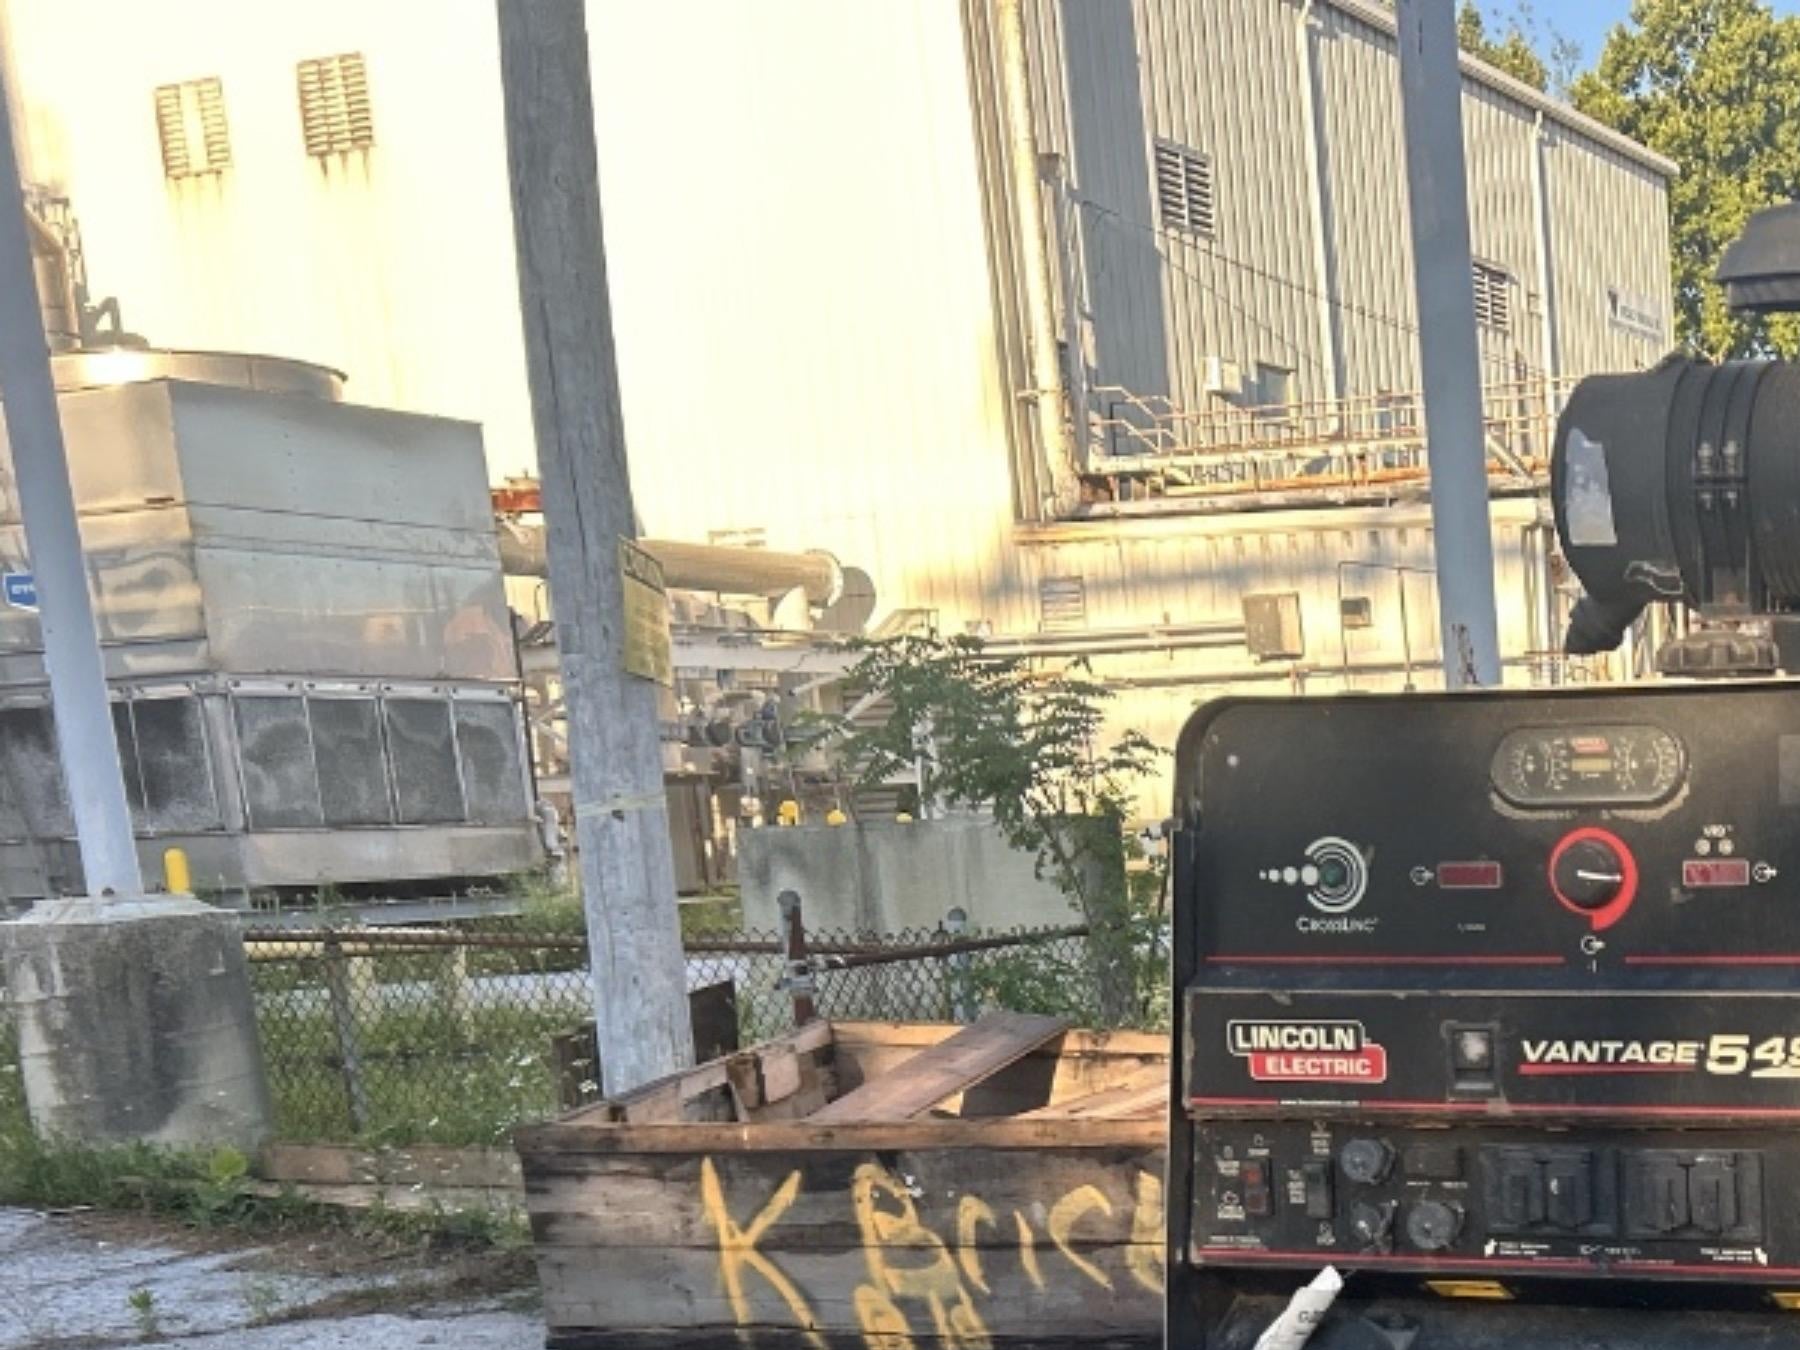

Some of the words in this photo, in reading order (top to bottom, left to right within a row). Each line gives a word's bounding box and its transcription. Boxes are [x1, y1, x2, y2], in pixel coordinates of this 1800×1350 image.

[1235, 1024, 1356, 1051] LINCOLN
[1520, 1038, 1698, 1064] VANTAGE
[1264, 1056, 1372, 1076] ELECTRIC
